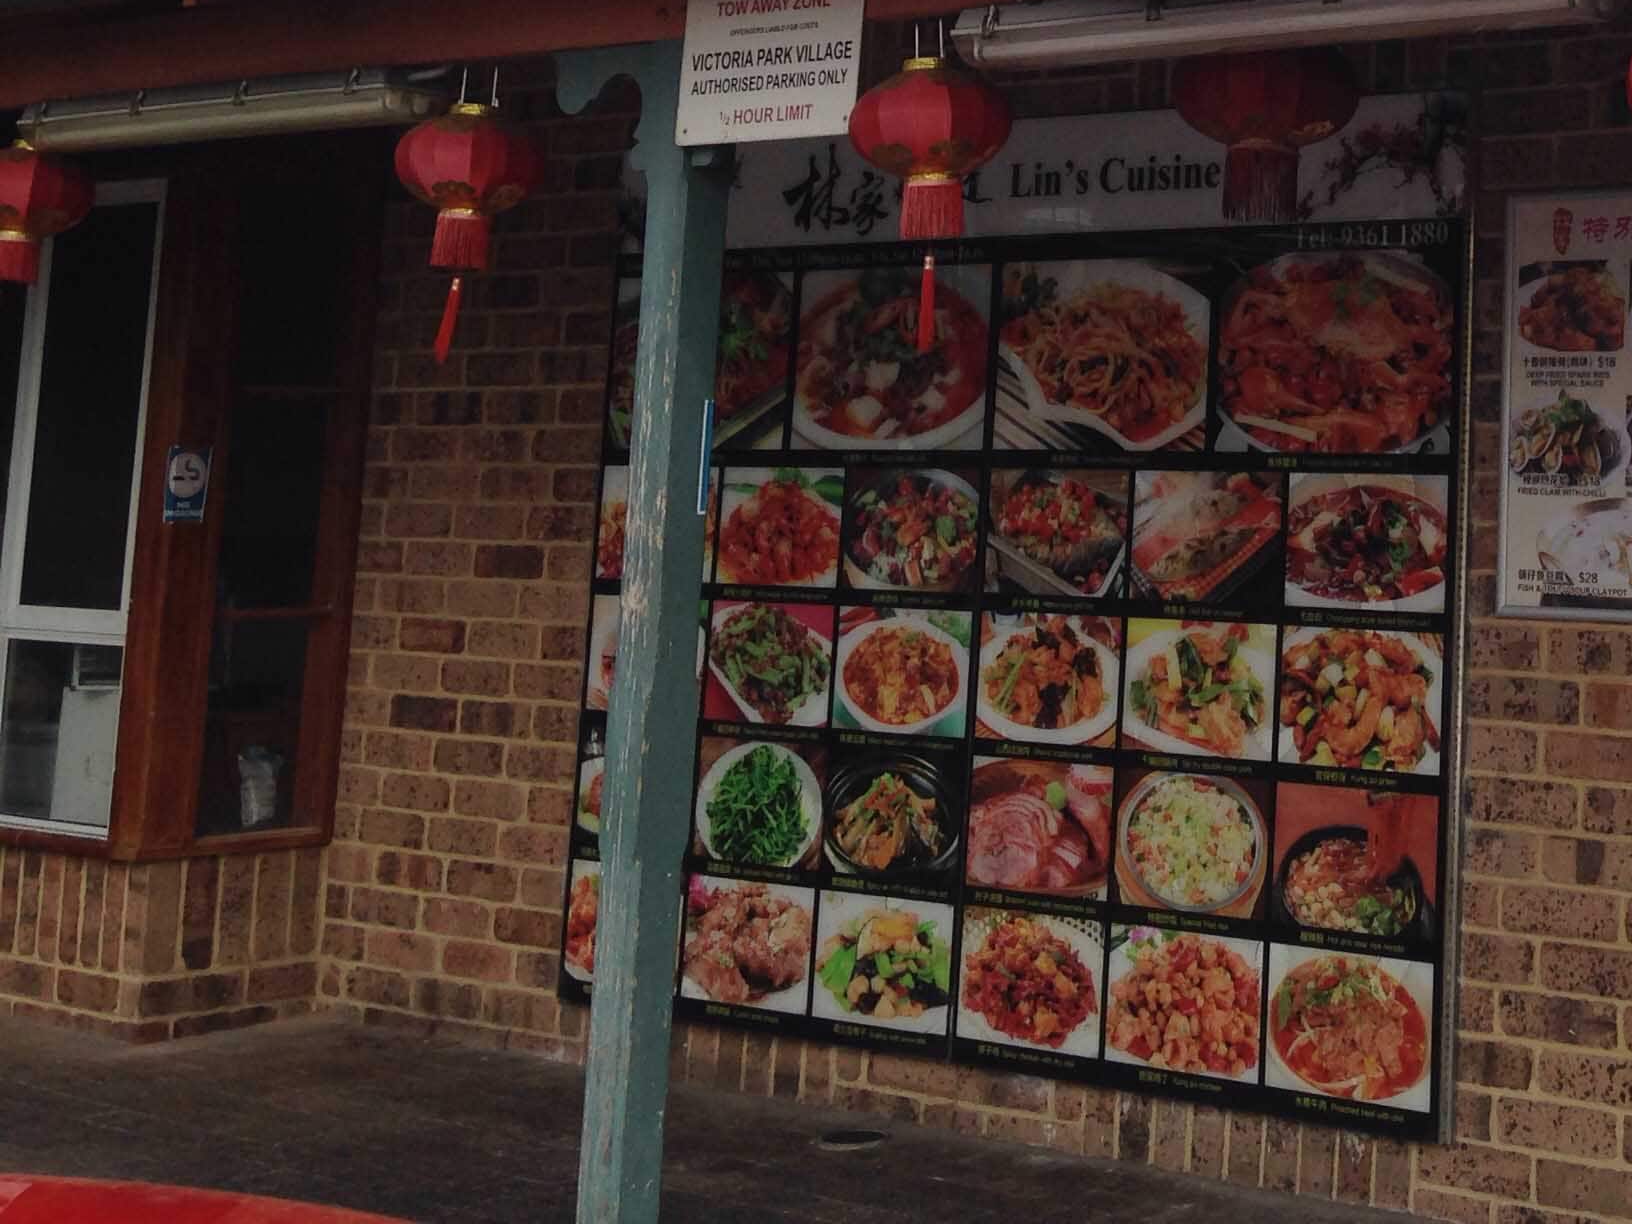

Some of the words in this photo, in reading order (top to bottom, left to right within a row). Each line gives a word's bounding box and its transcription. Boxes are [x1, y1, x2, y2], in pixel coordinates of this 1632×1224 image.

[717, 0, 750, 17] TOW
[692, 49, 754, 72] VICTORIA
[756, 45, 793, 67] PARK
[796, 40, 853, 63] VILLAGE
[691, 75, 764, 96] AUTHORISED
[766, 70, 816, 90] PARKING
[817, 68, 848, 86] ONLY
[733, 107, 774, 125] HOUR
[776, 104, 814, 122] LIMIT
[1009, 159, 1089, 198] Lin's
[1099, 153, 1221, 194] Cuisine
[1399, 220, 1450, 247] 1880
